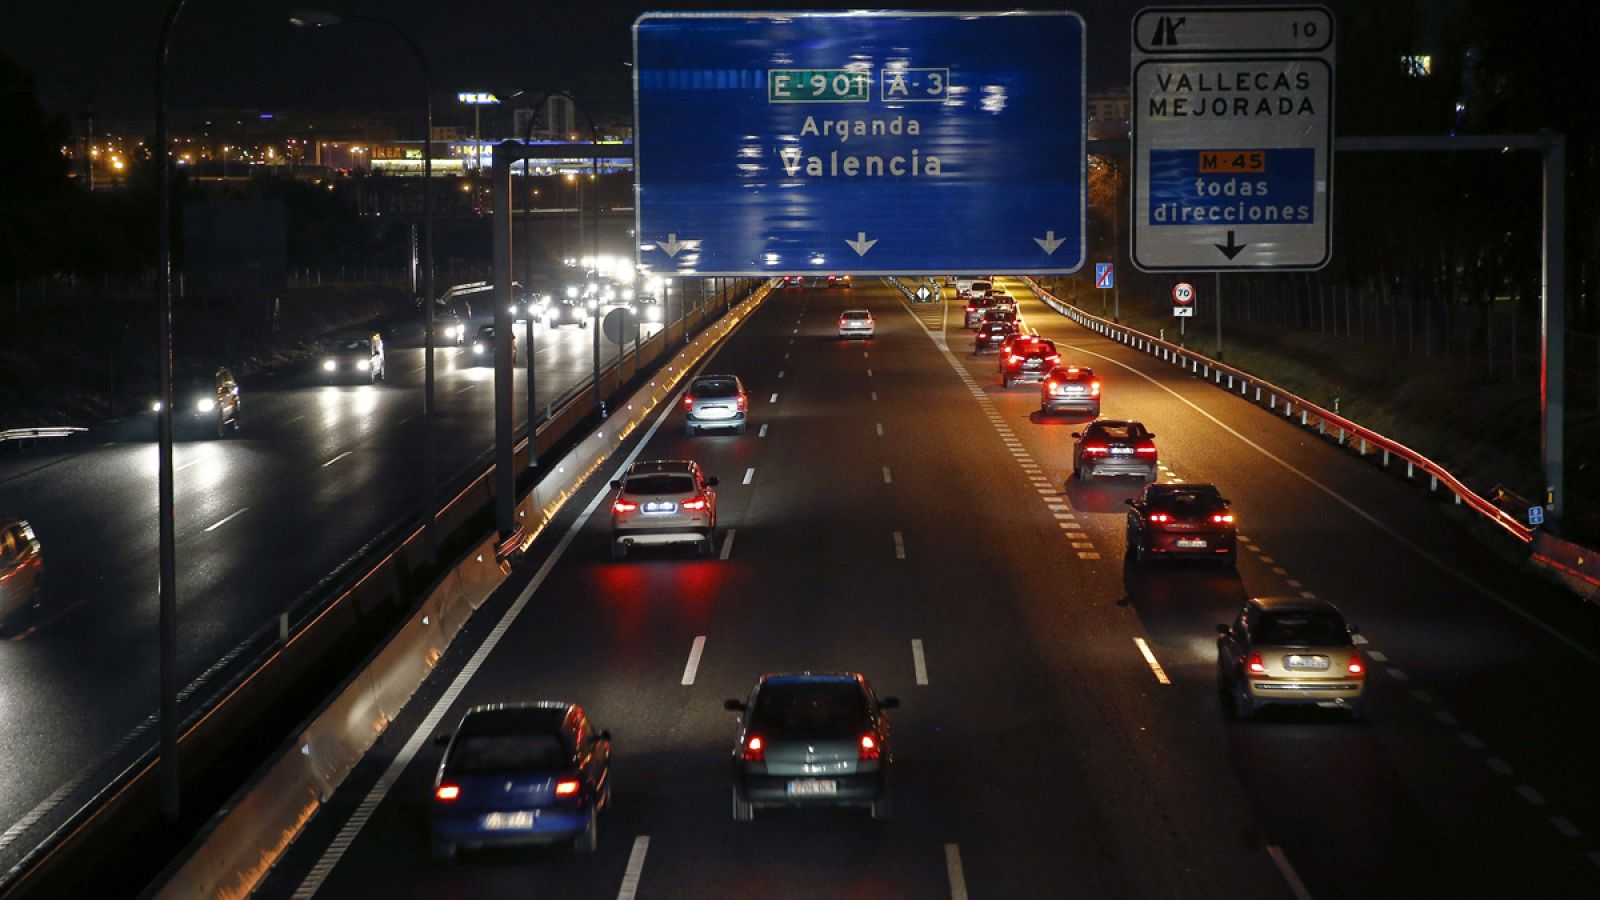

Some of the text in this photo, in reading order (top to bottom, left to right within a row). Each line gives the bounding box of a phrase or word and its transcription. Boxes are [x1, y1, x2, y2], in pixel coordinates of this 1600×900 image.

[1292, 21, 1317, 38] 10
[774, 74, 865, 97] E-901
[887, 73, 943, 96] A-3
[1157, 72, 1310, 92] VALLECAS
[1149, 97, 1315, 117] MEJORADA
[800, 115, 920, 143] Arganda
[779, 148, 942, 177] Valencia
[1203, 154, 1263, 169] M-45
[1195, 177, 1269, 197] todas
[1153, 202, 1310, 222] direcciones
[1178, 288, 1190, 297] 70
